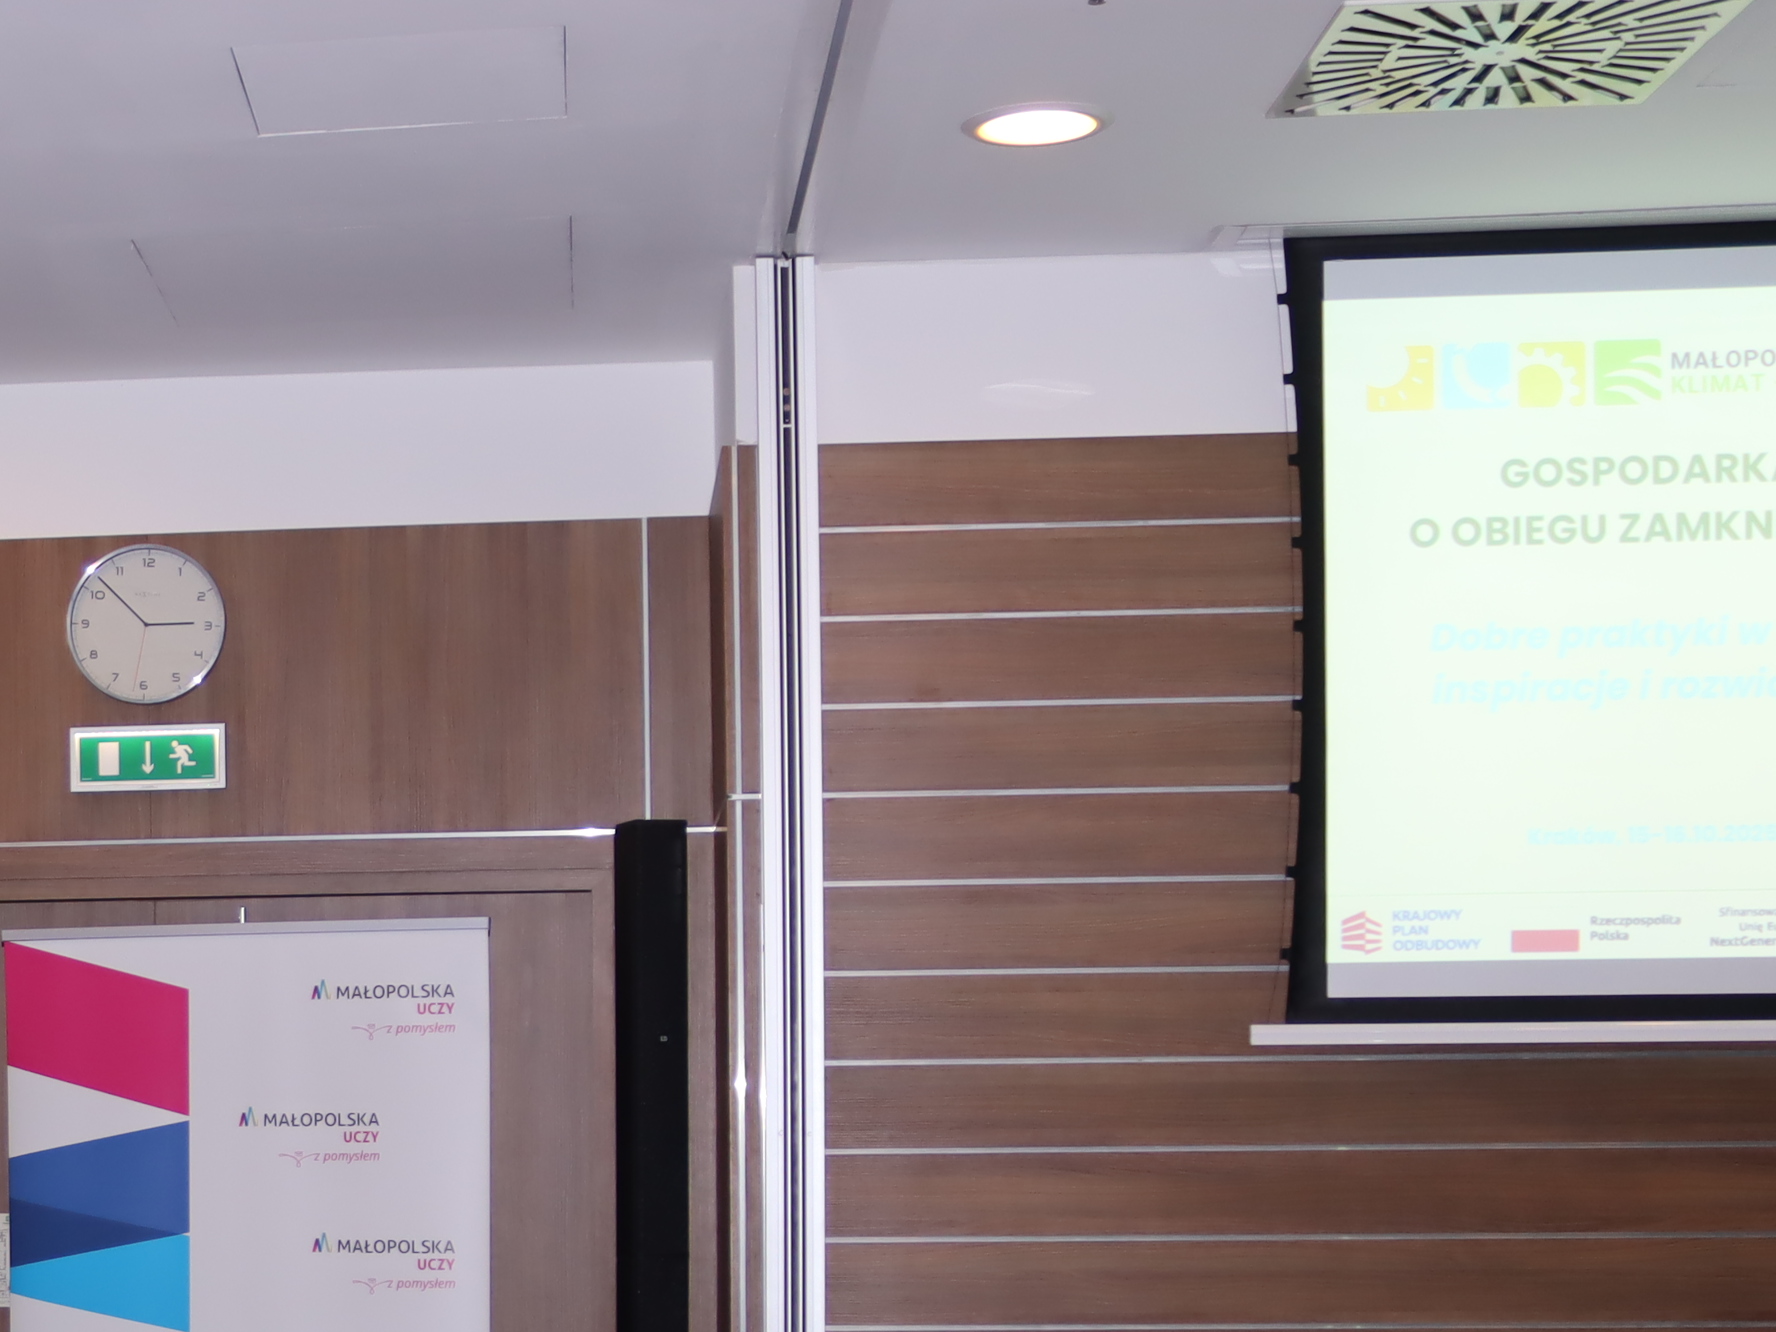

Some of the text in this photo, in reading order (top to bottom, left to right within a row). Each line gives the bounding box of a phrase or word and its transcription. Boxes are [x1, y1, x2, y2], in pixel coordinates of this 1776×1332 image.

[1670, 348, 1776, 370] MAŁOPO
[1671, 373, 1765, 394] KLIMAT
[1409, 518, 1440, 548] O
[1451, 514, 1607, 547] OBIEGU
[142, 557, 156, 567] 12
[116, 567, 124, 576] 11
[90, 590, 105, 600] 10
[197, 592, 206, 602] 2
[81, 619, 90, 629] 9
[204, 621, 212, 630] 3
[89, 650, 98, 659] 8
[194, 650, 203, 660] 4
[111, 673, 119, 682] 7
[172, 673, 181, 682] 5
[140, 681, 148, 690] 6
[1392, 909, 1463, 922] KRAJOWY
[1590, 914, 1682, 928] Rzeczpospolita
[1392, 925, 1429, 936] PLAN
[1590, 930, 1629, 941] Polska
[1392, 938, 1482, 952] ODBUDOWY
[336, 984, 455, 1000] MAŁOPOLSKA
[417, 1002, 455, 1015] UCZY
[395, 1022, 456, 1036] pomysłem
[263, 1112, 380, 1127] MAŁOPOLSKA
[343, 1131, 379, 1143] UCZY
[323, 1150, 380, 1164] pomysłem
[337, 1239, 455, 1254] MAŁOPOLSKA
[417, 1258, 455, 1270] UCZY
[396, 1277, 456, 1291] pomysłem
